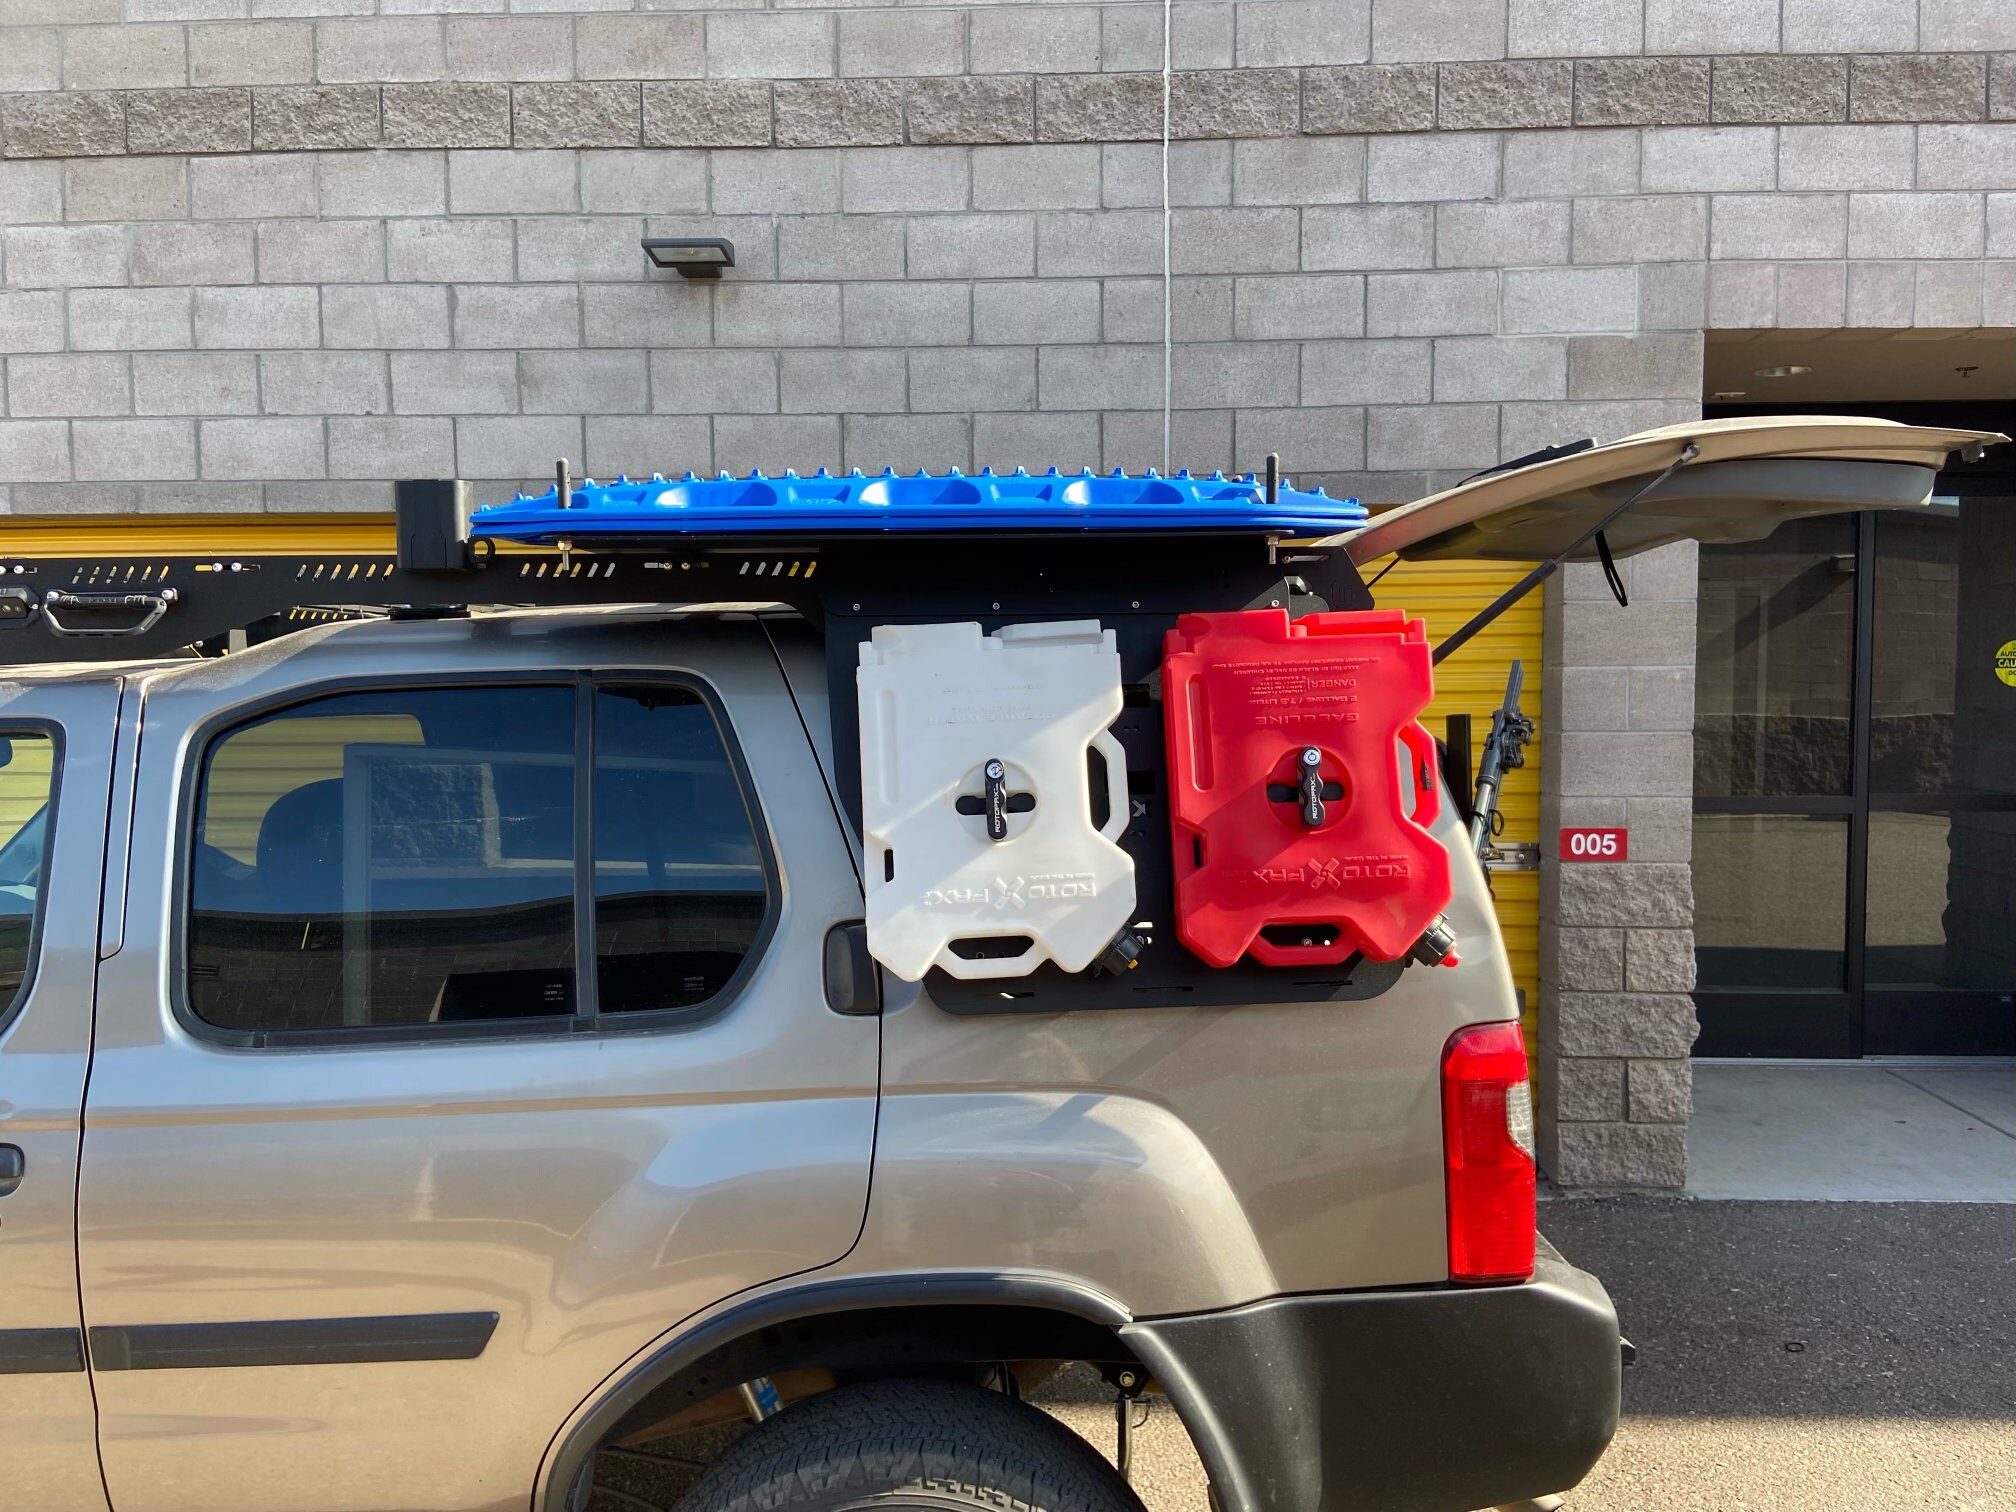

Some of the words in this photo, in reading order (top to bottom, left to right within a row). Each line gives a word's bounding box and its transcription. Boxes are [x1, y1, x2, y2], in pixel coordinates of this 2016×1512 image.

[1311, 678, 1357, 688] DANGER
[1570, 833, 1617, 855] 005
[1343, 863, 1412, 880] ROTO
[1028, 882, 1098, 899] ROTO
